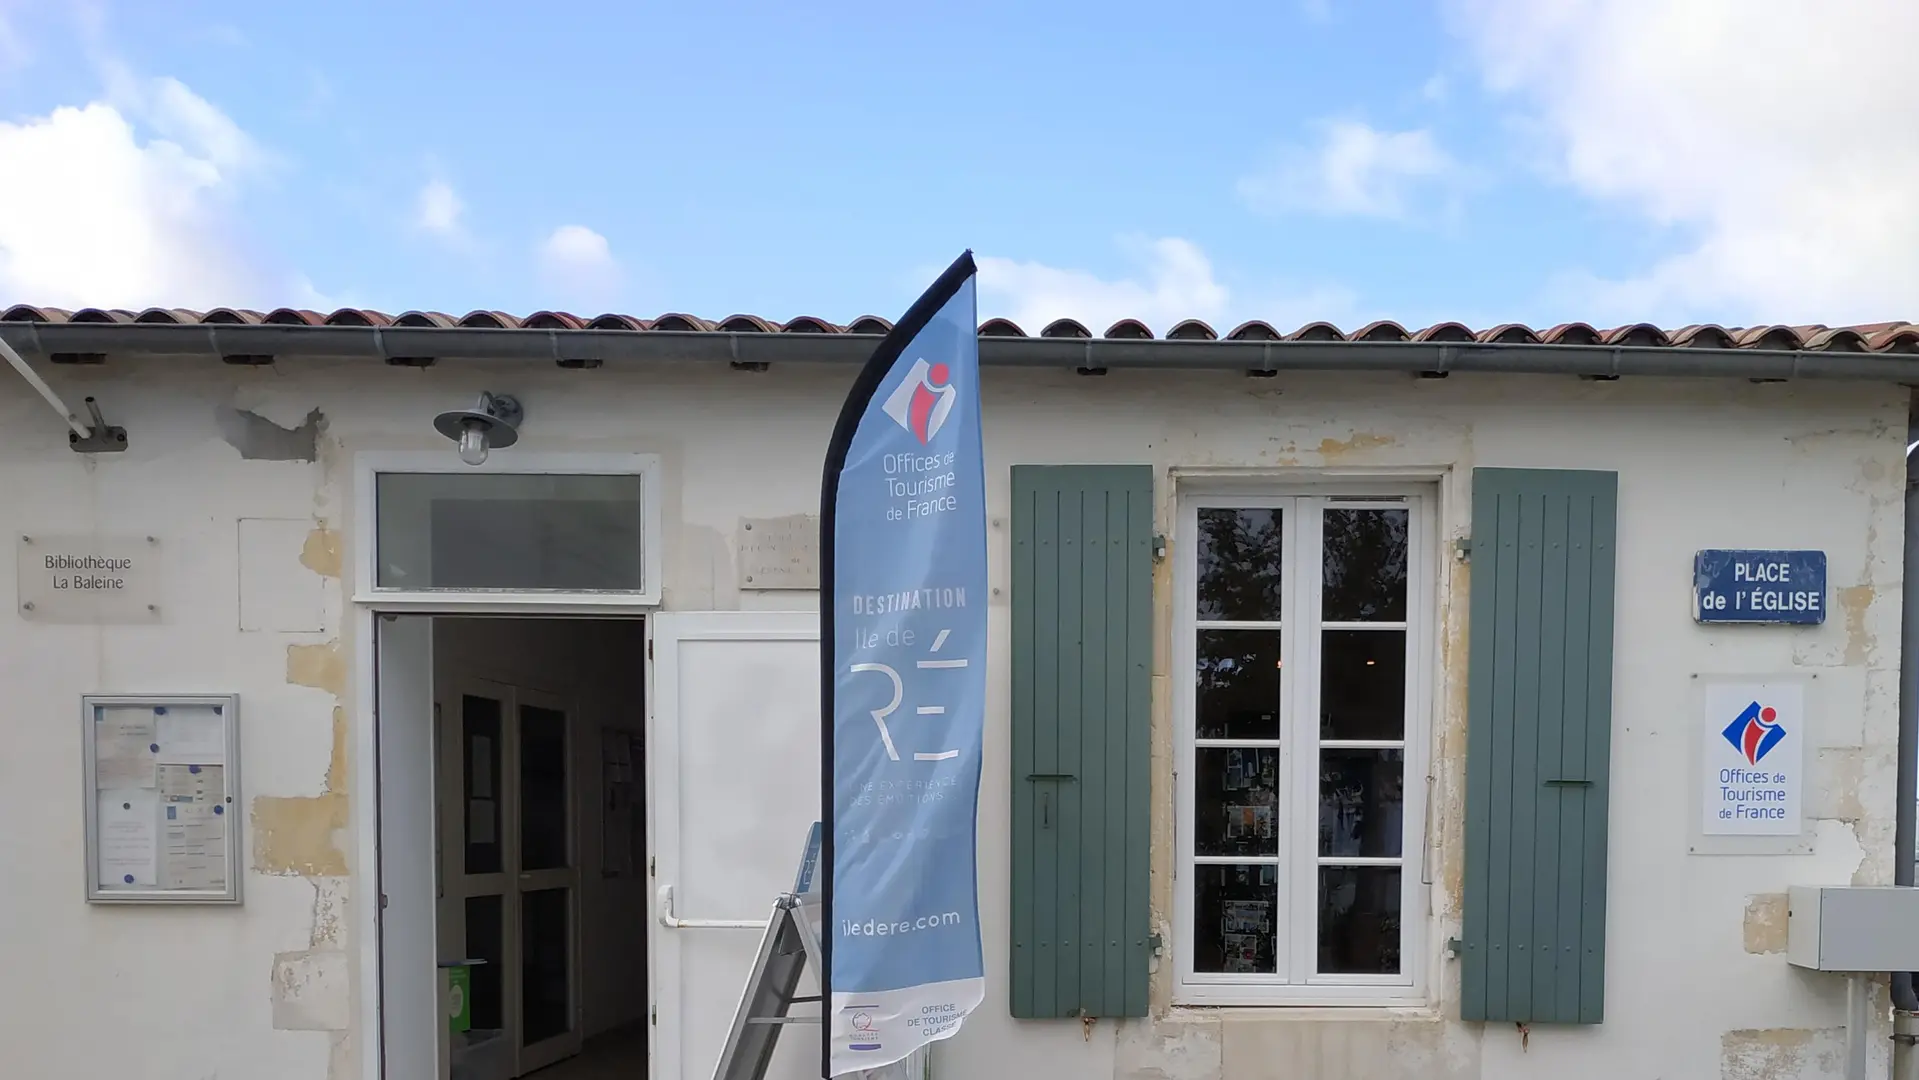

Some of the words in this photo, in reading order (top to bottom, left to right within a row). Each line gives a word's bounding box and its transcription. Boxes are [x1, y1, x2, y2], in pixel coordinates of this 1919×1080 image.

[883, 452, 941, 474] Offices
[944, 450, 955, 466] de
[885, 472, 955, 497] Tourisme
[886, 507, 903, 521] de
[907, 495, 957, 519] France
[45, 554, 132, 573] Bibliothèque
[1734, 562, 1790, 582] PLACE
[53, 575, 68, 589] La
[74, 575, 124, 590] Baleine
[853, 586, 967, 616] DESTINATION
[1702, 591, 1727, 610] de
[886, 623, 916, 648] de
[850, 628, 969, 762] RÉ
[1720, 768, 1769, 784] Offices
[1772, 773, 1786, 784] de
[1720, 786, 1786, 801] Tourisme
[1719, 808, 1732, 819] de
[1736, 804, 1785, 819] France
[842, 911, 960, 937] iledere.com
[907, 1018, 921, 1027] DE
[923, 1009, 967, 1025] TOURISME
[921, 1003, 956, 1016] OFFICE
